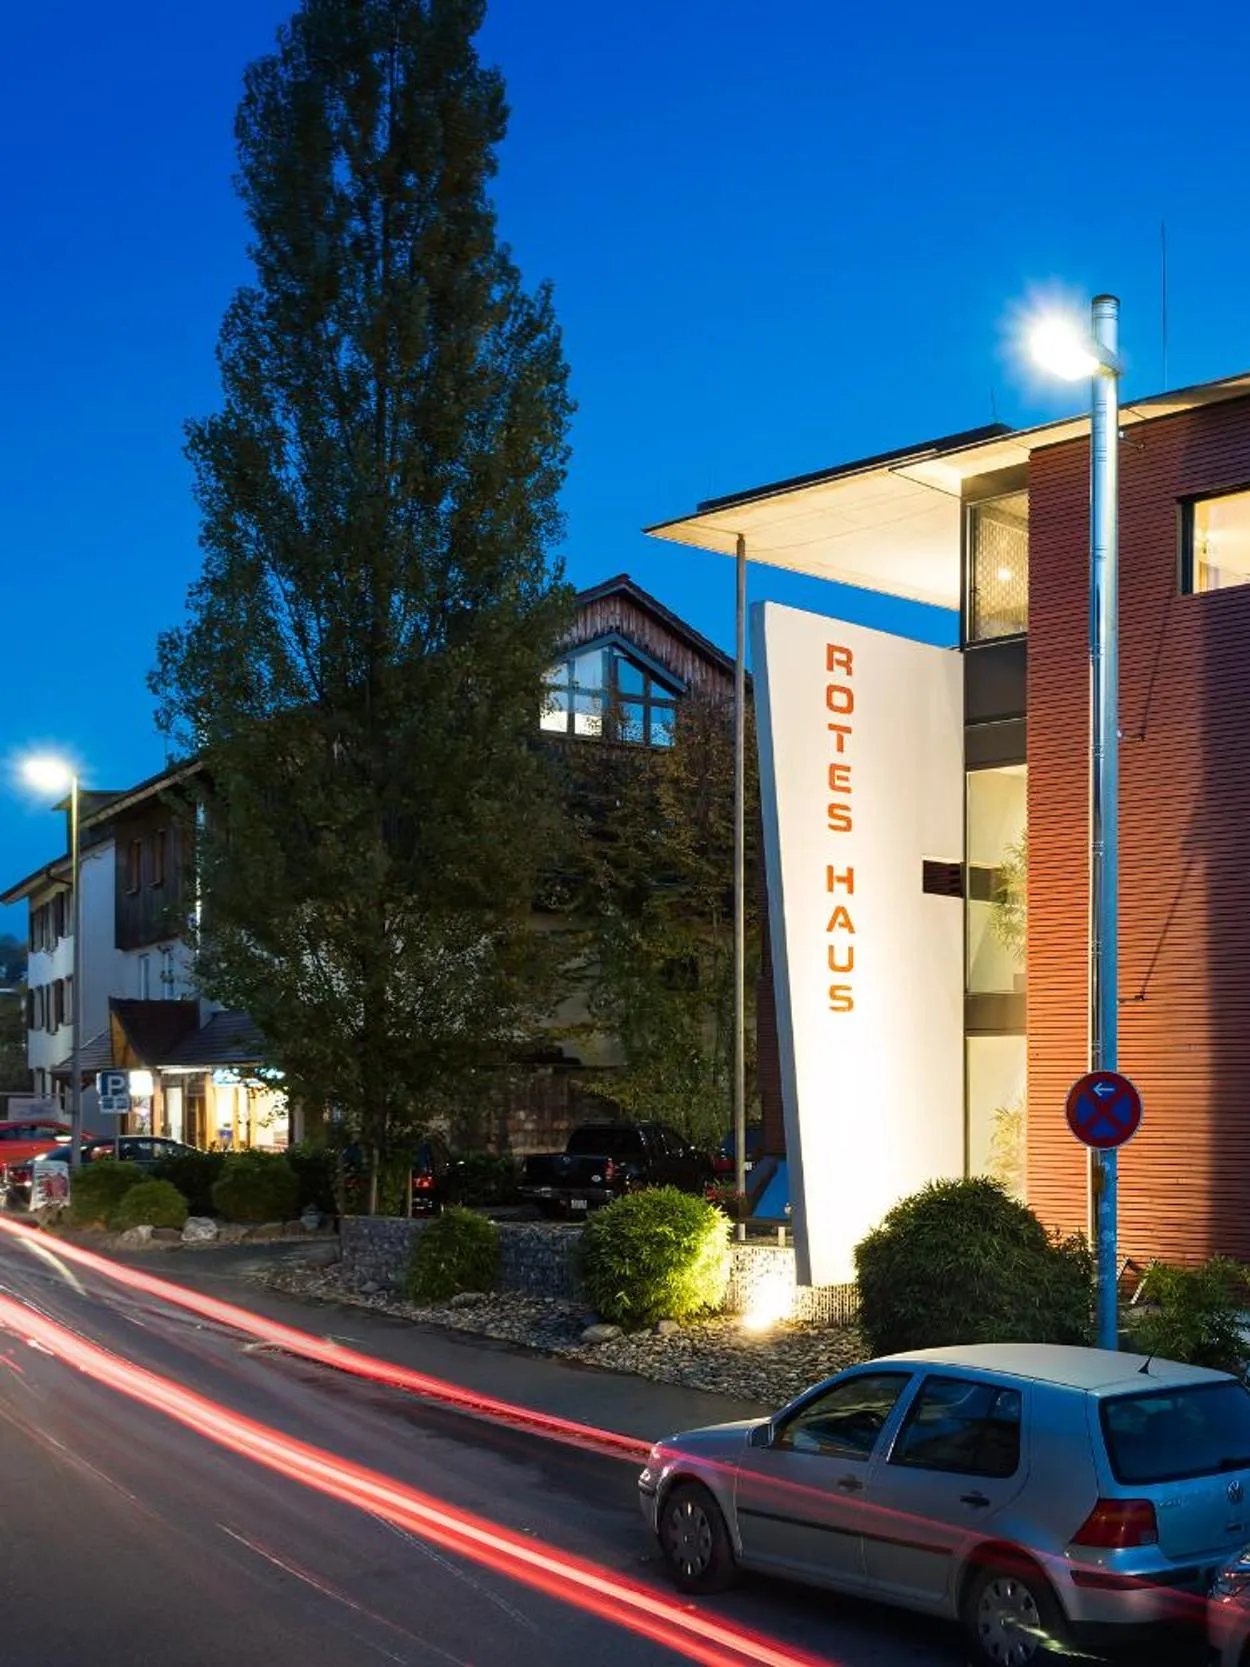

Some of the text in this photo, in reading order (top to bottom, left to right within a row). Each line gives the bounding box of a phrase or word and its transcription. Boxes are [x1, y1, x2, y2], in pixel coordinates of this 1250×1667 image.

[825, 643, 856, 1013] ROTES HAUS
[107, 1075, 125, 1096] P
